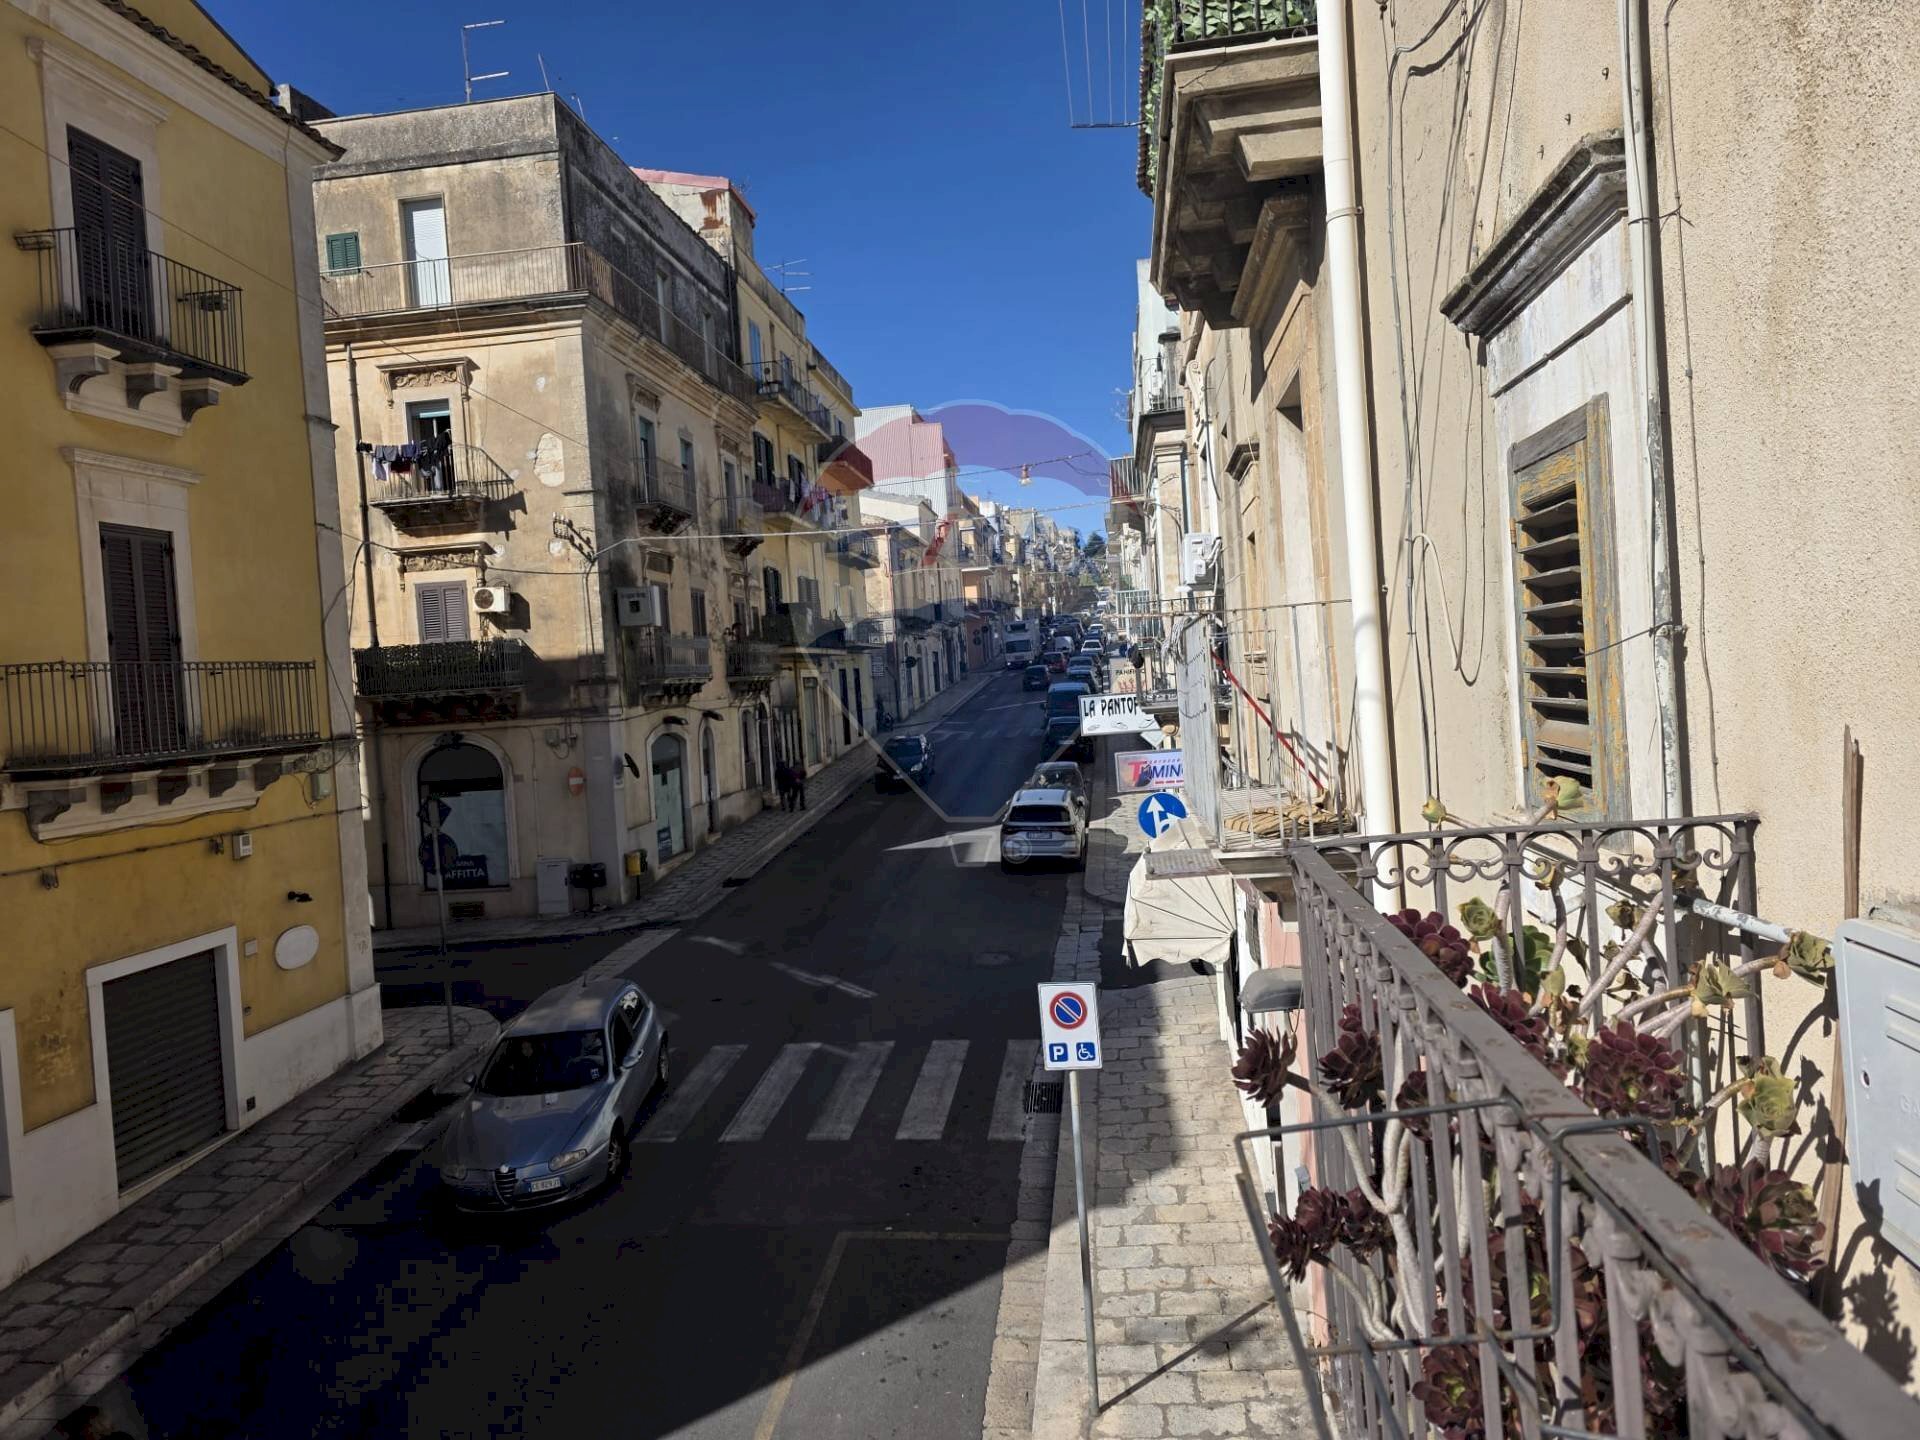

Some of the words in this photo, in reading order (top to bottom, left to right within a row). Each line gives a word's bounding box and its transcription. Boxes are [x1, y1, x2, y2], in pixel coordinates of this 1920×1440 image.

[1083, 699, 1096, 718] LA
[1127, 760, 1183, 783] TMIN
[1053, 1045, 1065, 1061] P
